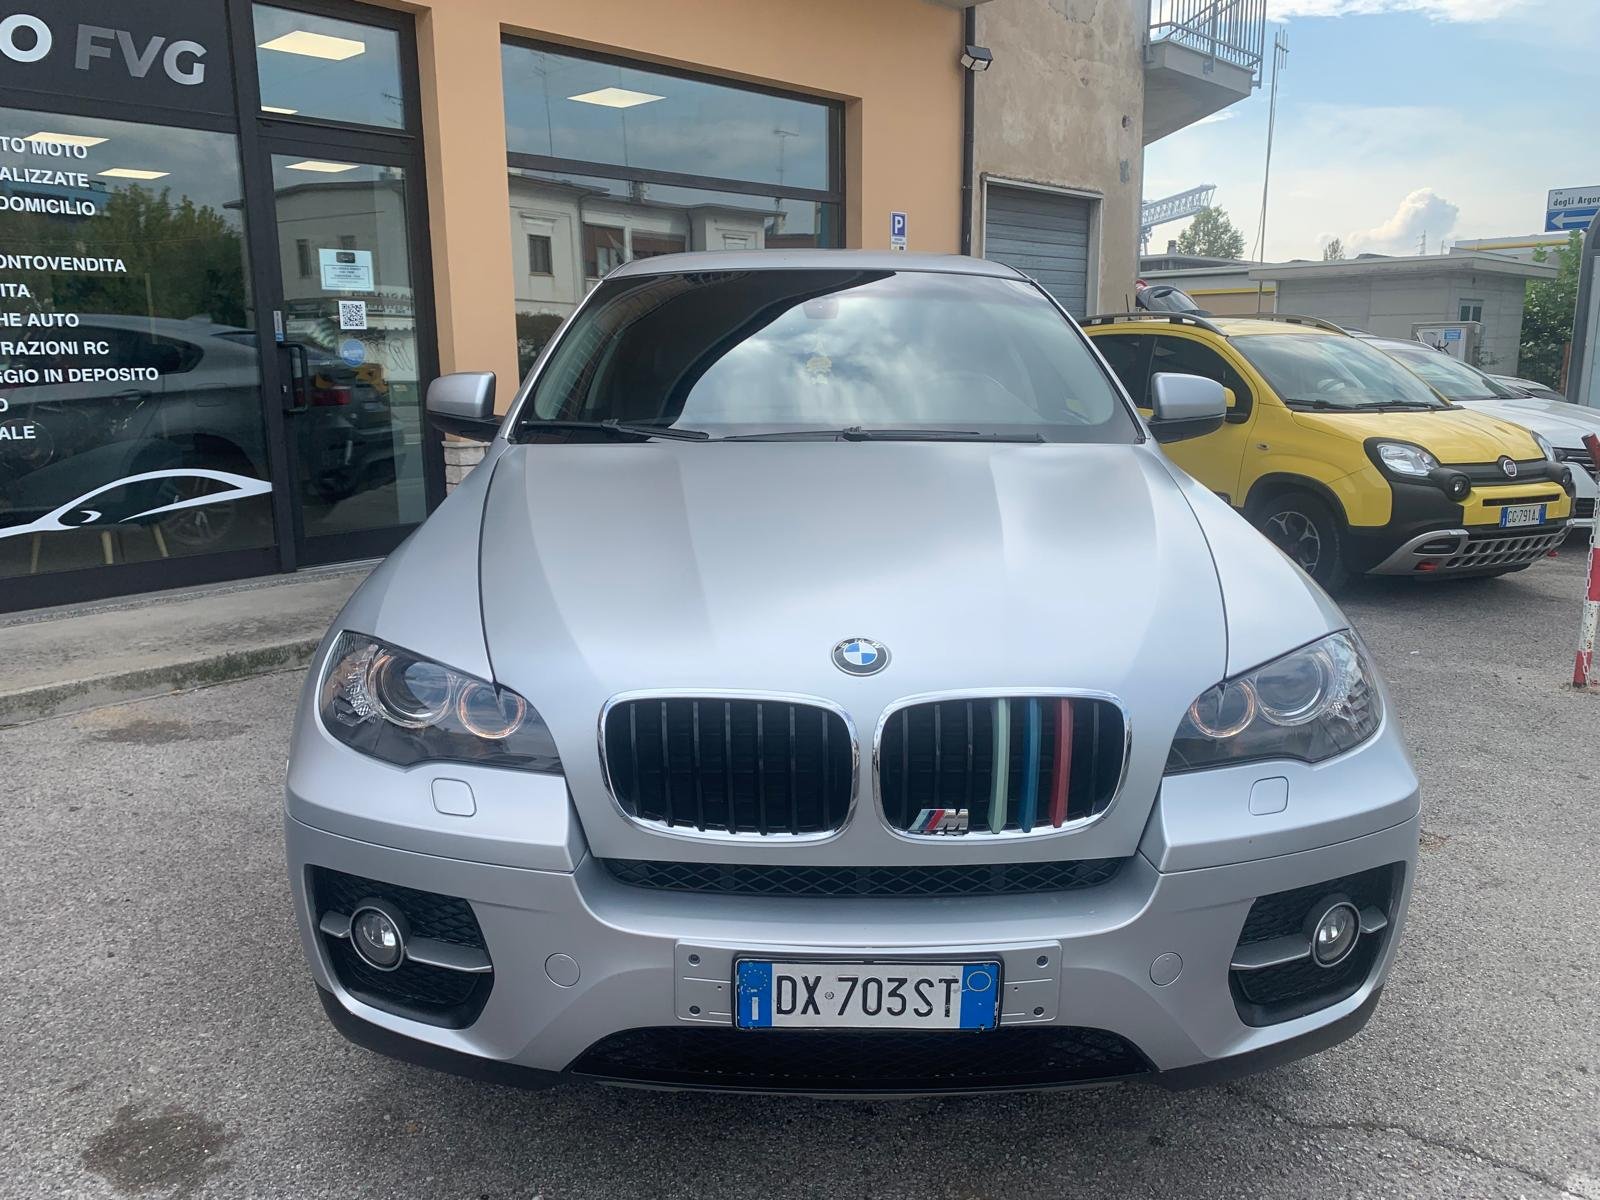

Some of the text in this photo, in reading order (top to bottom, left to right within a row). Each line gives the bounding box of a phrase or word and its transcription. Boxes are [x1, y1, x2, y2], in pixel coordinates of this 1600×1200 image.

[0, 14, 207, 85] O FVG
[0, 136, 88, 159] TO MOTO
[0, 166, 90, 188] ALIZZATE
[0, 196, 96, 216] DOMICILIO
[1554, 197, 1574, 207] degli
[894, 215, 904, 234] P
[0, 283, 31, 298] ITA
[27, 313, 80, 328] AUTO
[0, 340, 110, 356] RAZIONI RC
[0, 366, 159, 384] GIO IN DEPOSITO
[0, 425, 36, 440] ALE
[776, 975, 822, 1015] DX
[837, 976, 960, 1018] 703ST
